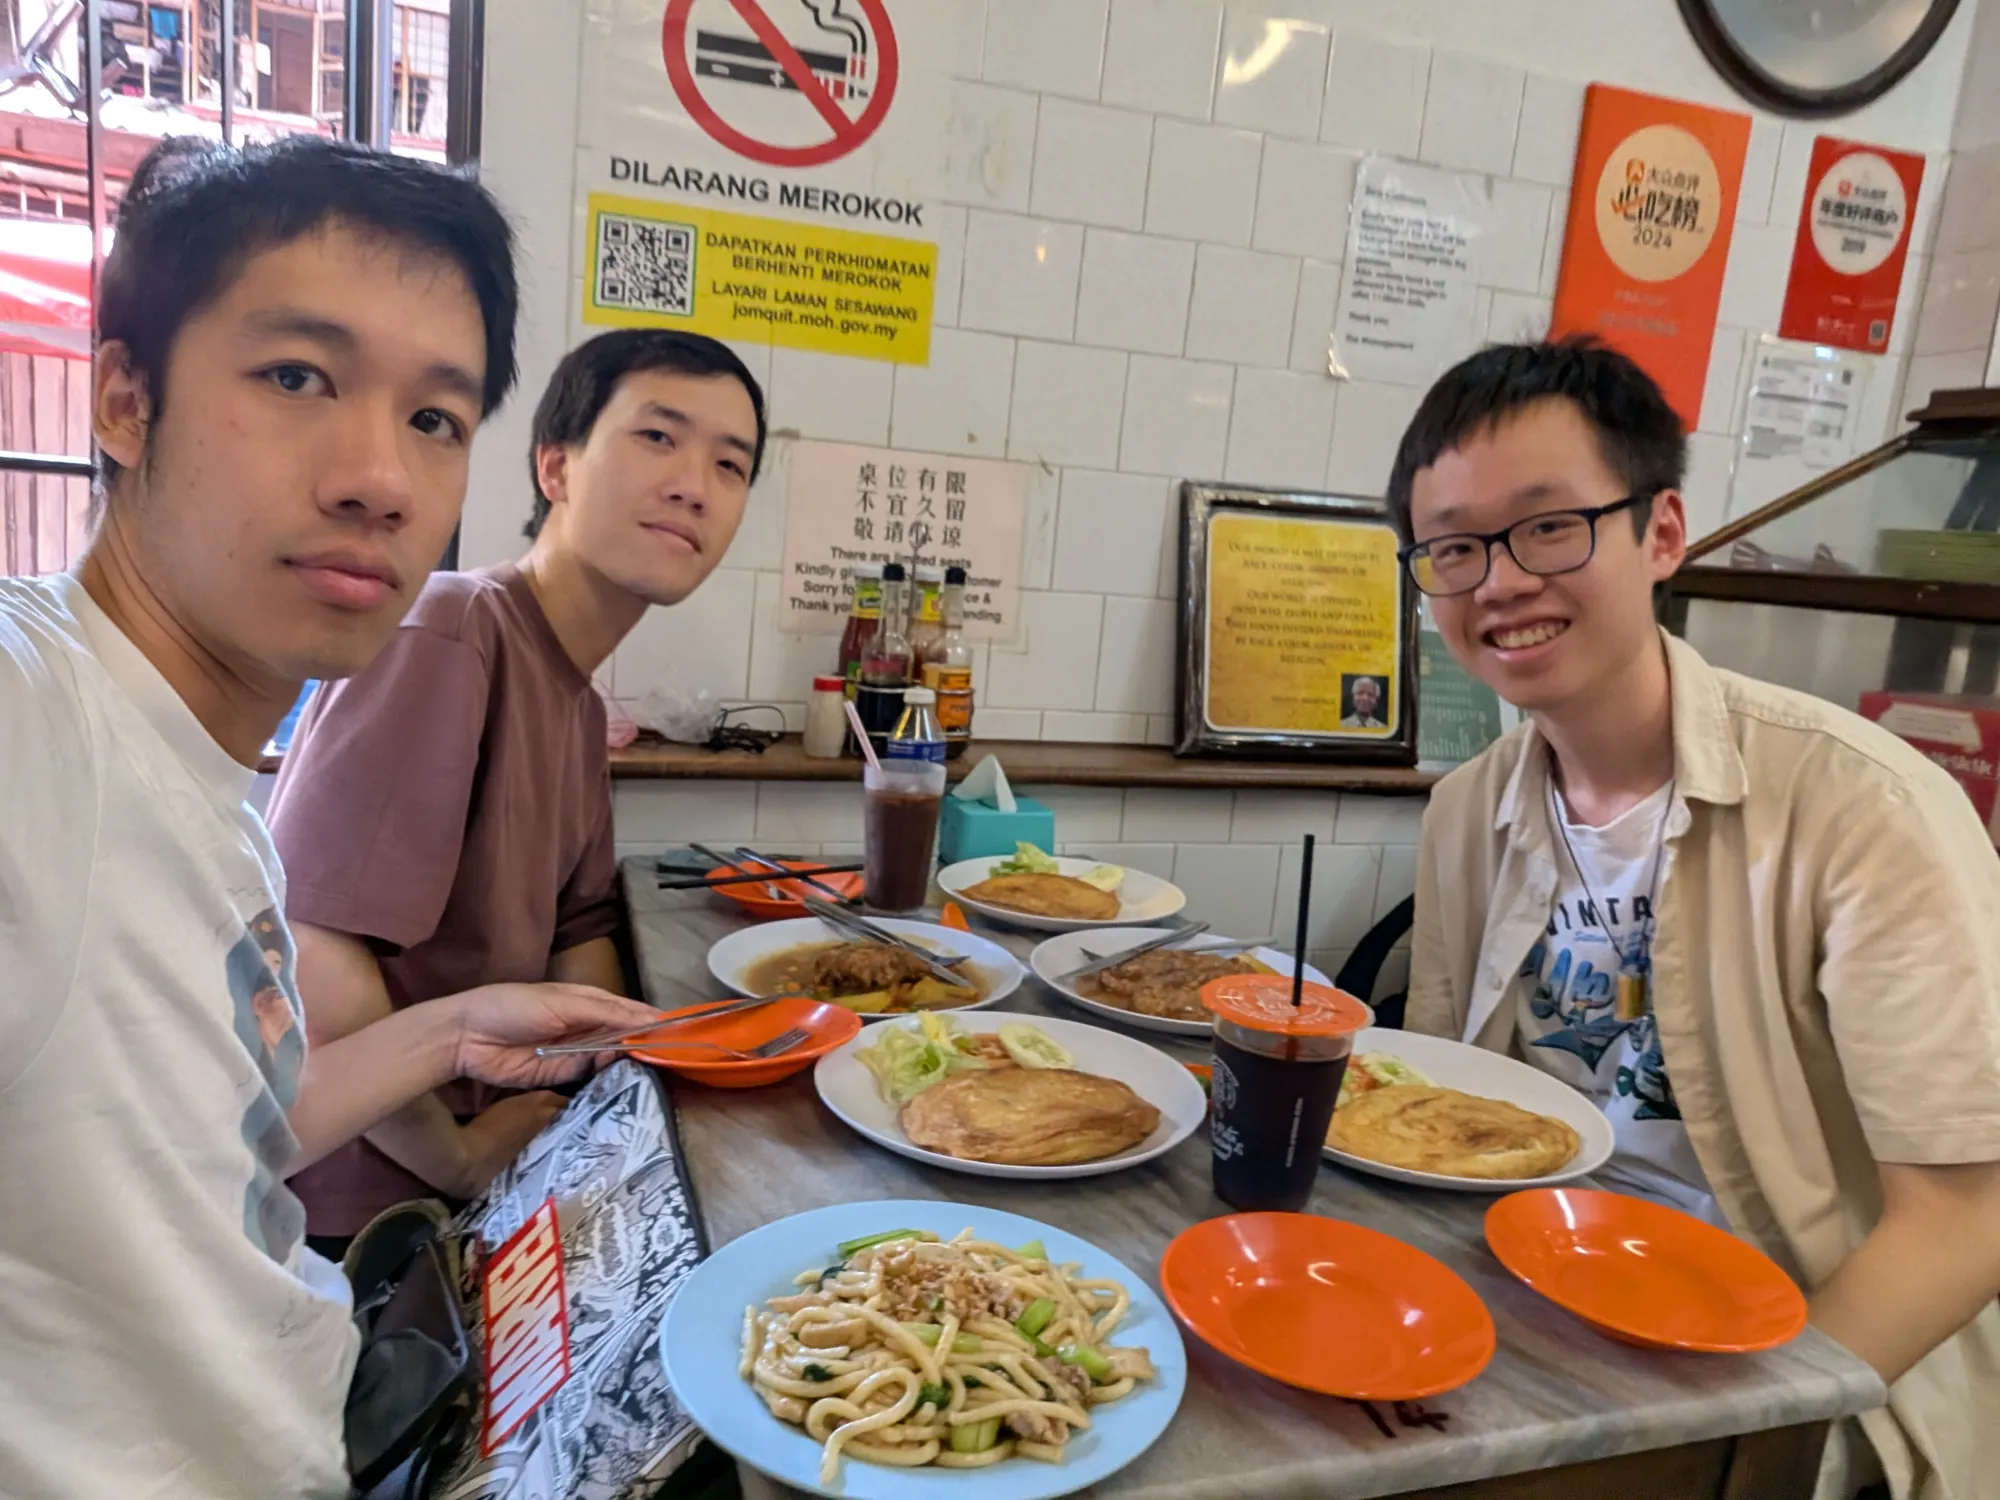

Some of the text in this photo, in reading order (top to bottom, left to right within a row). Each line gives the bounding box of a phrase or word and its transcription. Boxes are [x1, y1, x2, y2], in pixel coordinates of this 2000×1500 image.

[610, 156, 923, 226] DILARANG MEROKOK
[1633, 227, 1672, 249] 2024
[706, 232, 930, 279] DAPATKAN PERKHIDMATAN
[732, 255, 902, 292] BERHENTI MEROKOK
[712, 282, 918, 322] LAYARI LAMAN SESAWANG
[732, 302, 898, 341] jomquit.moh.gov.my
[858, 461, 966, 495] 桌位有限
[857, 489, 966, 521] 不宜久留
[795, 562, 836, 578] Kindly
[830, 546, 866, 561] There
[870, 552, 890, 562] are
[939, 558, 972, 569] seats
[790, 596, 829, 611] Thank
[803, 580, 838, 597] Sorry
[842, 583, 856, 596] fo
[983, 592, 991, 604] &
[486, 1199, 569, 1449] MARVEL
